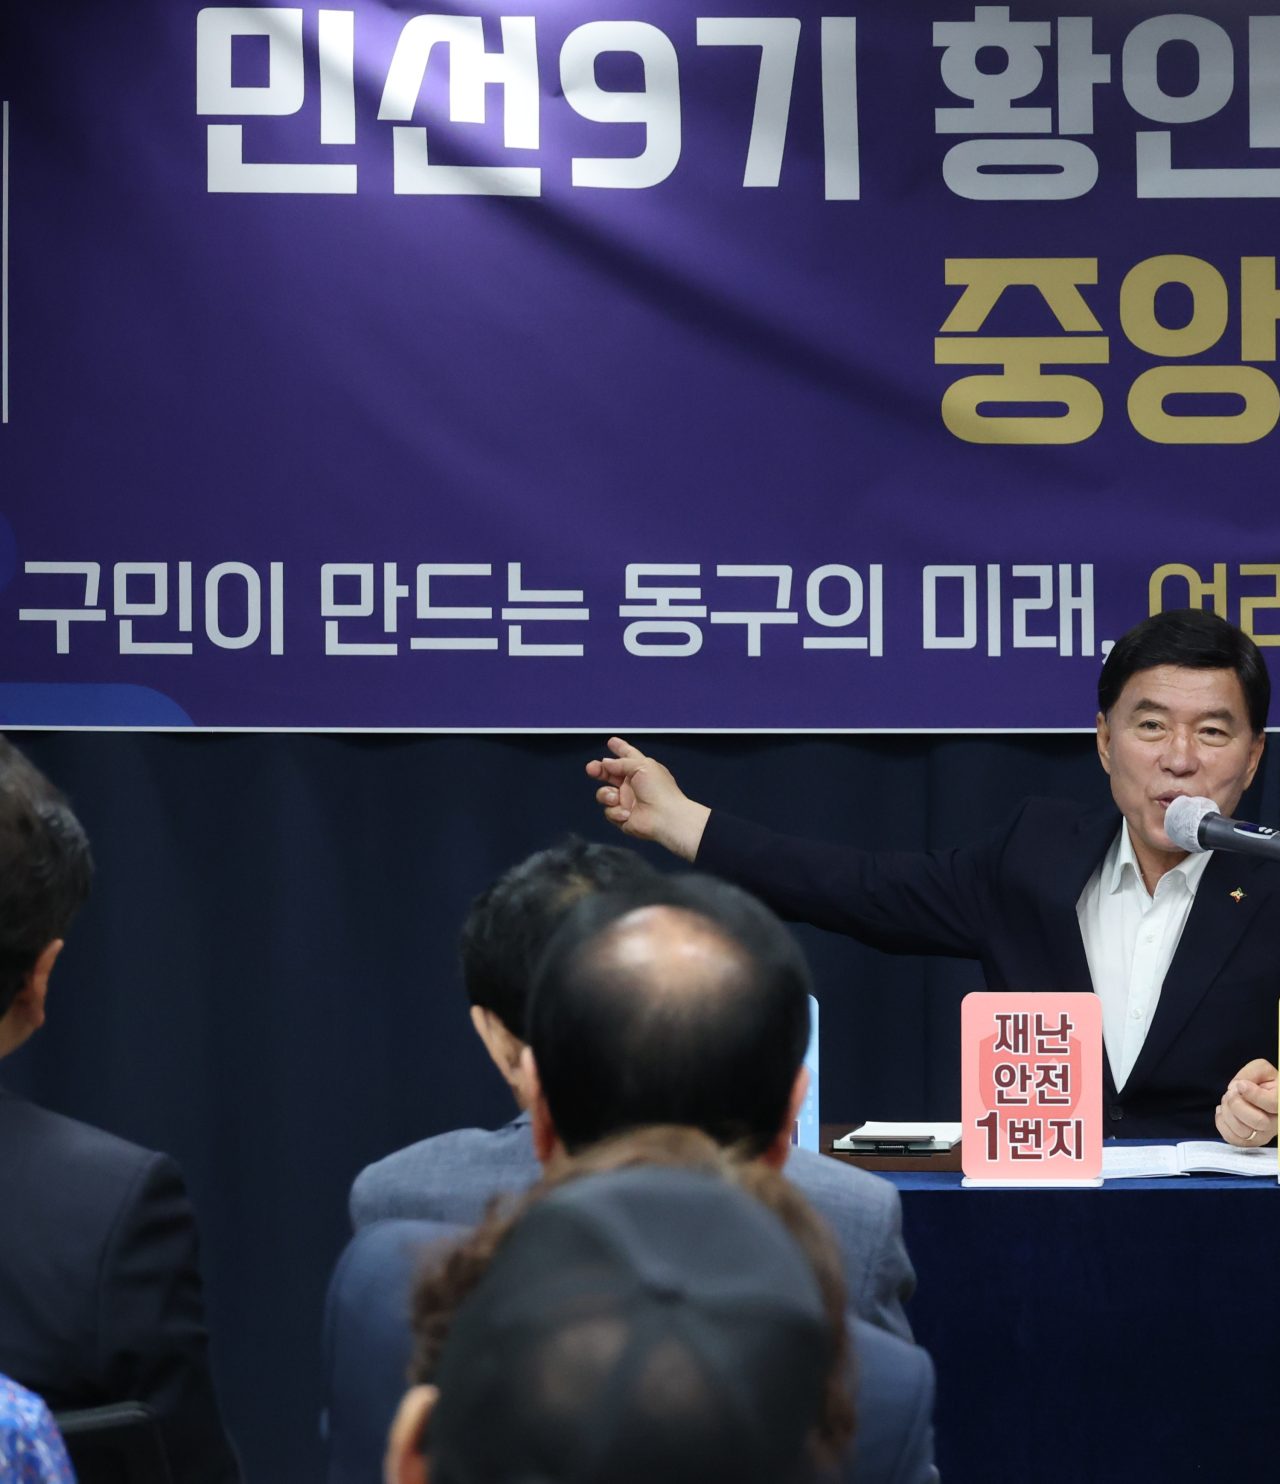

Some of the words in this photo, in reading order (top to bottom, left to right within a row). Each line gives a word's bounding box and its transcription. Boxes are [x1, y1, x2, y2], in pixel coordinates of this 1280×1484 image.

[196, 7, 860, 201] 민선9기
[18, 561, 284, 656] 구민이
[320, 561, 590, 657] 만드는
[618, 562, 884, 658] 동구의
[922, 563, 1116, 665] 미래,
[994, 1014, 1073, 1054] 재난
[994, 1064, 1070, 1105] 안전
[976, 1111, 1083, 1160] 1번지
